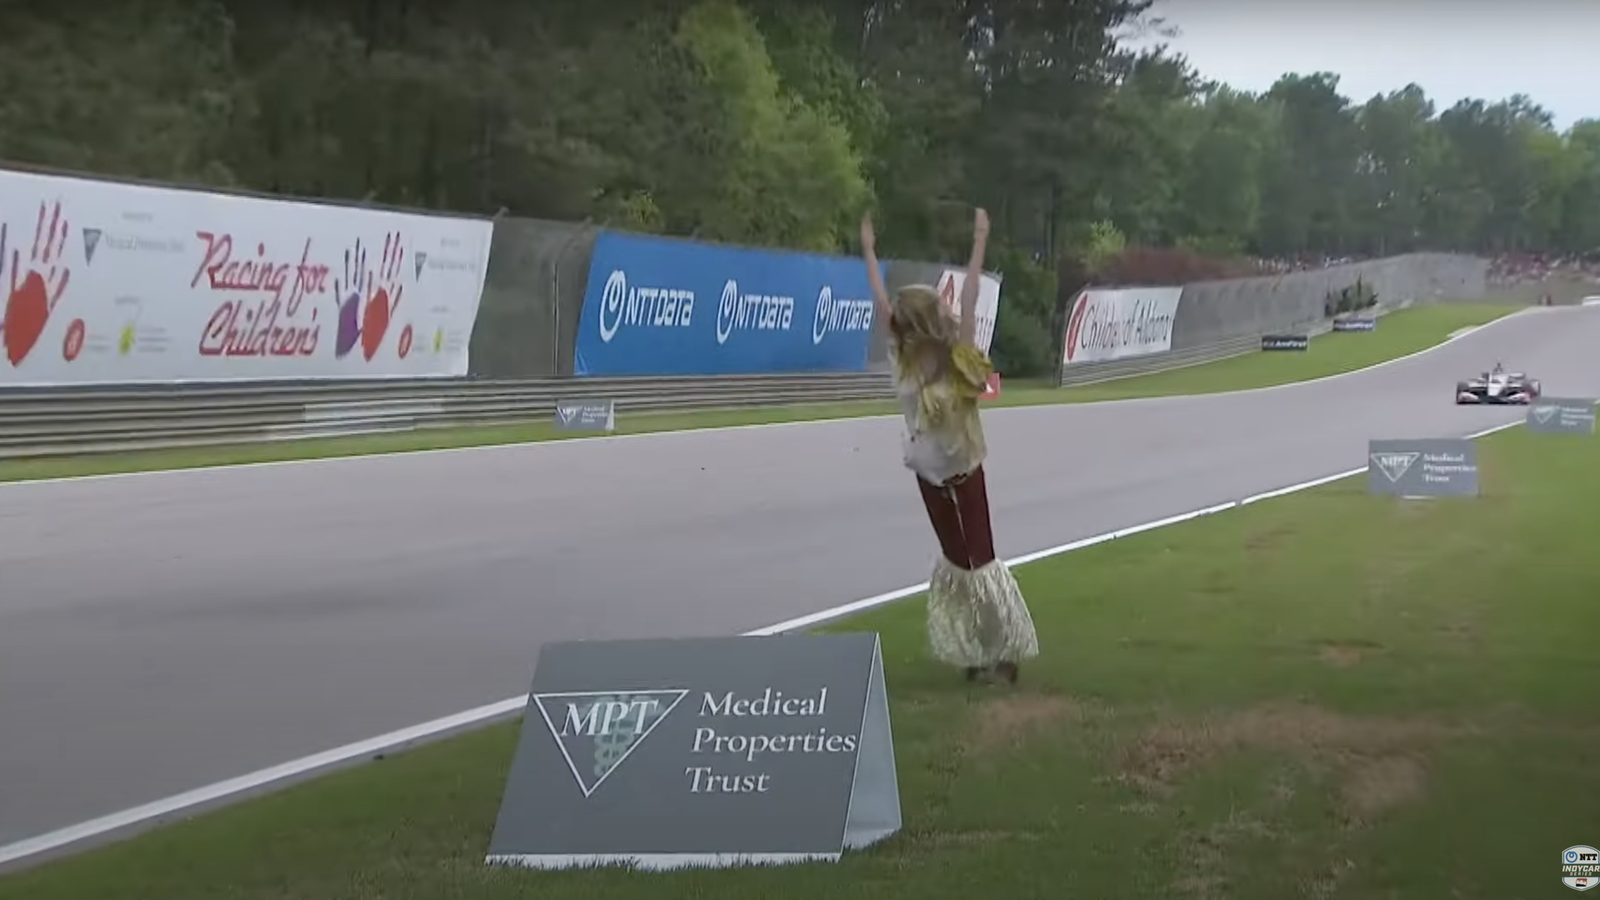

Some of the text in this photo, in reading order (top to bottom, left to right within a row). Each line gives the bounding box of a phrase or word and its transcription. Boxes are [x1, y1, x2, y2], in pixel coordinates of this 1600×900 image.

[190, 231, 330, 318] Racing for
[198, 300, 320, 357] Children's
[560, 687, 828, 738] MPT Medical
[690, 727, 857, 762] Properties
[684, 766, 771, 793] Trust
